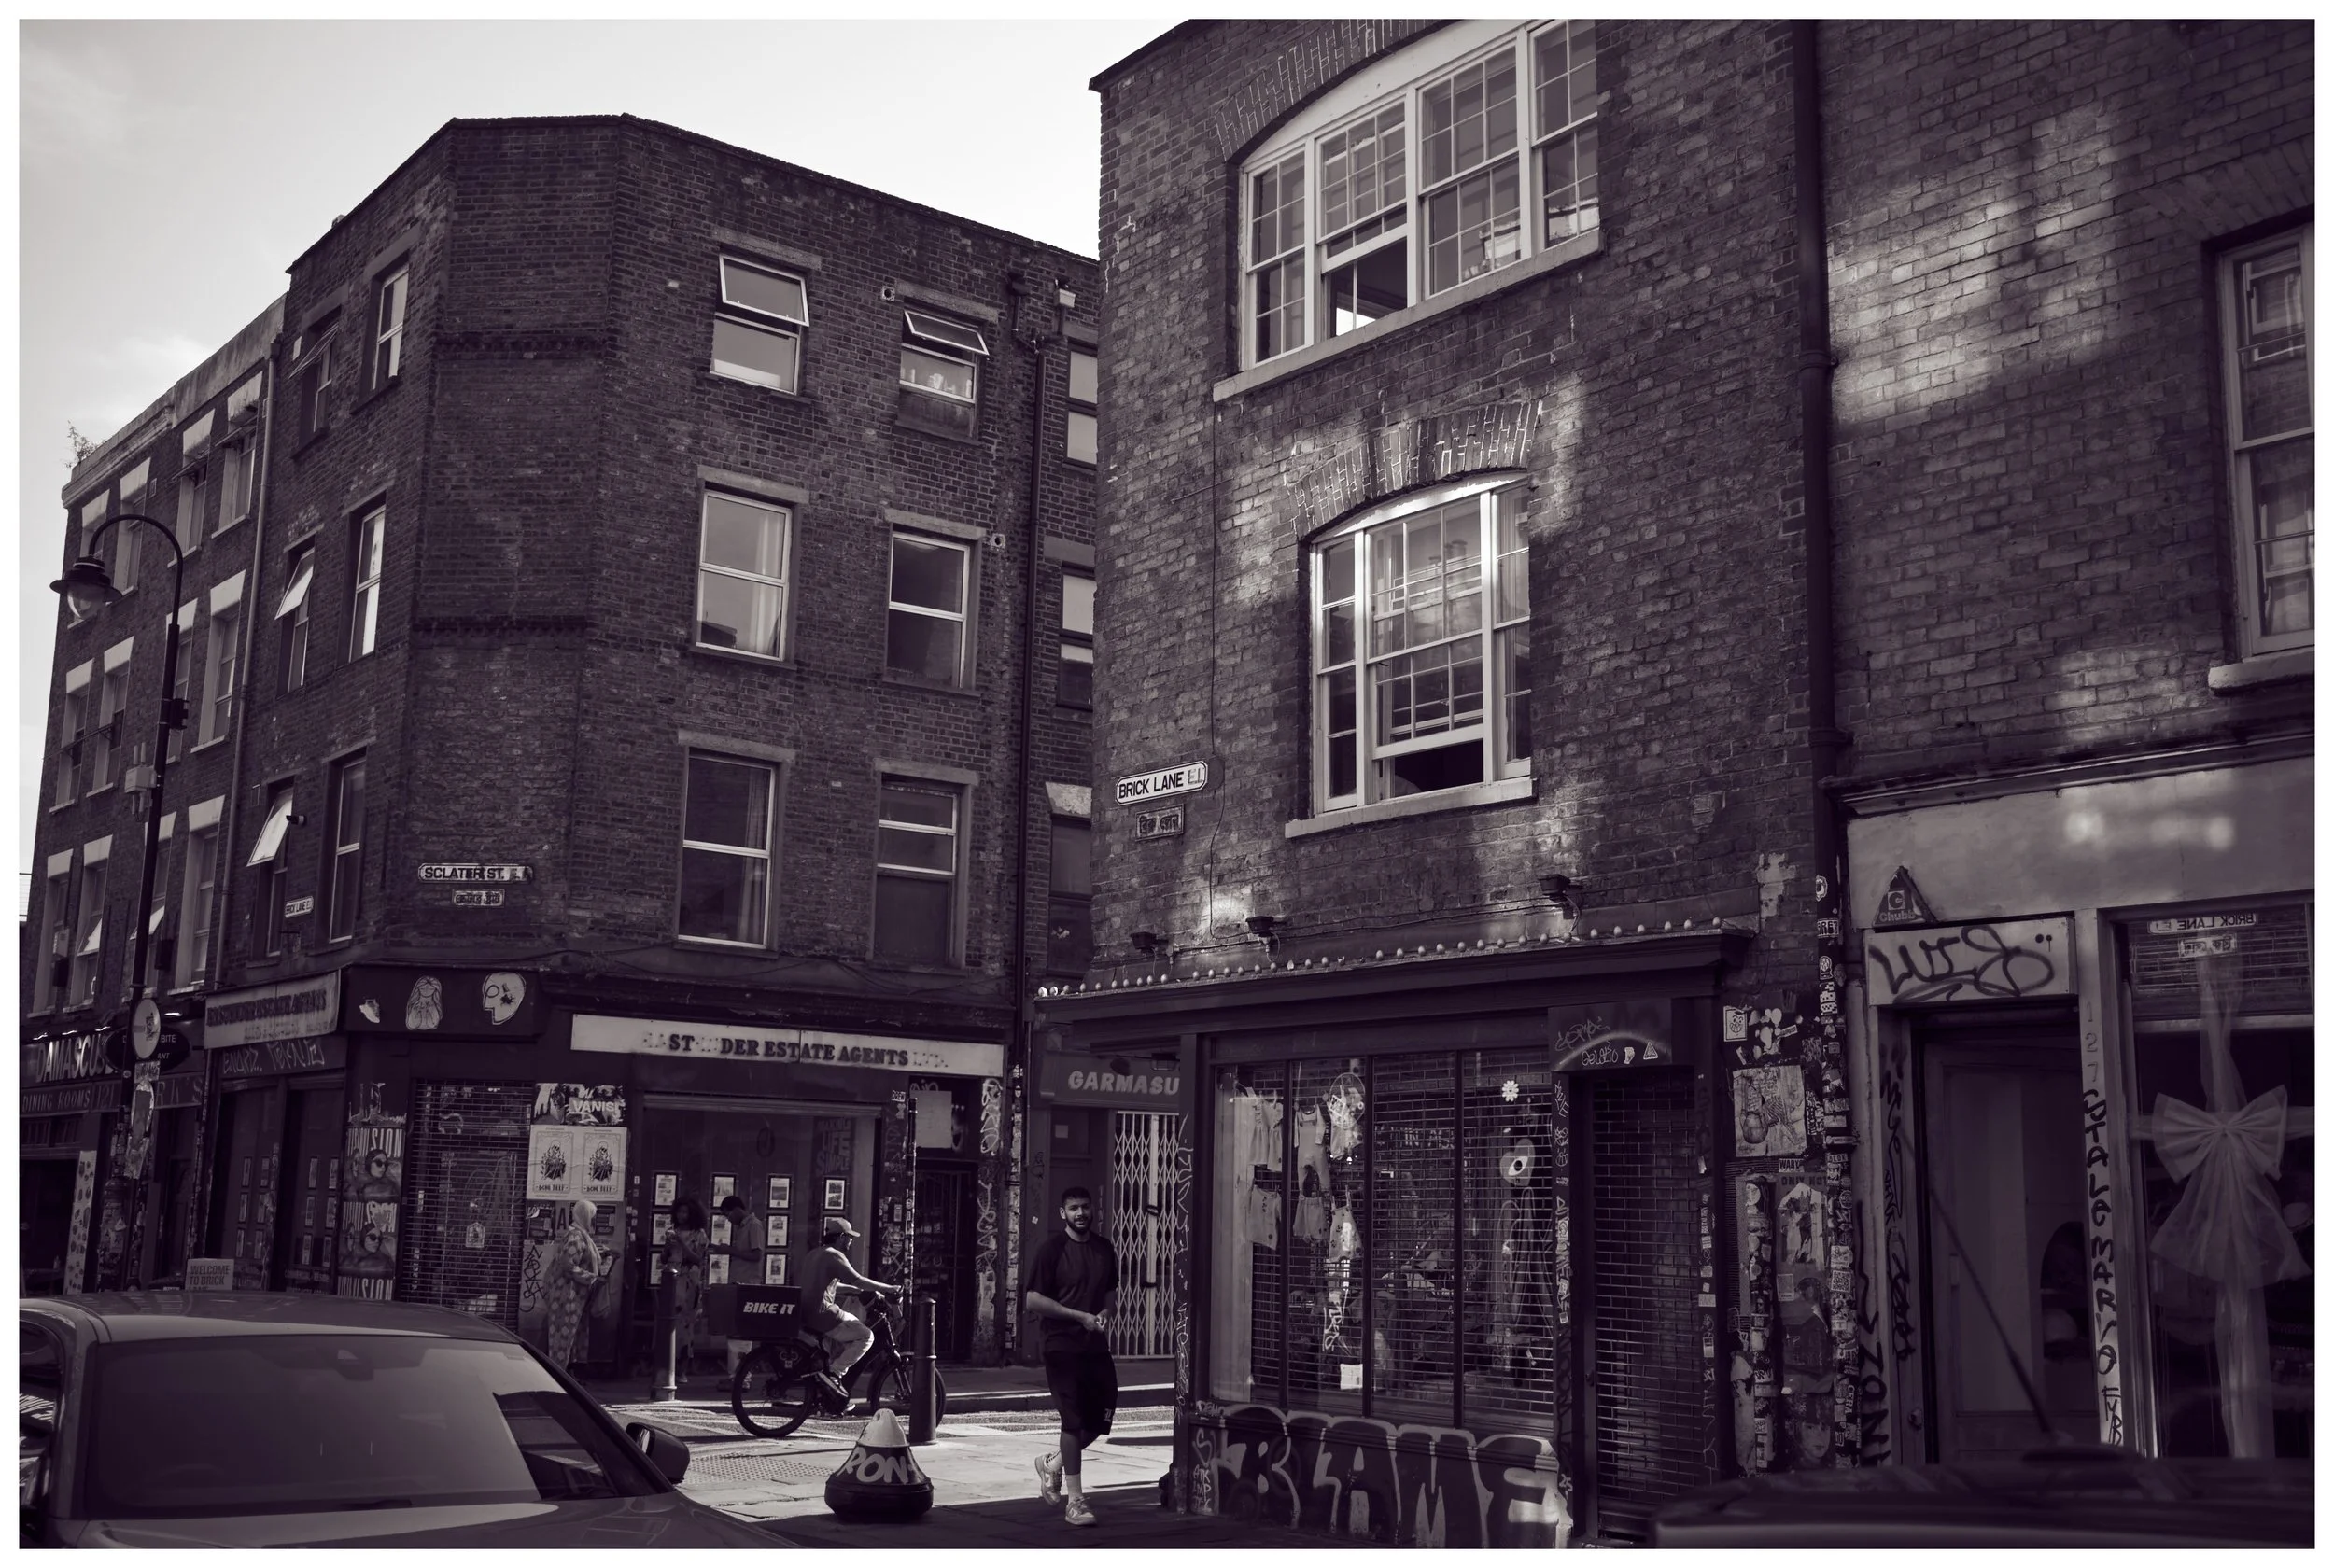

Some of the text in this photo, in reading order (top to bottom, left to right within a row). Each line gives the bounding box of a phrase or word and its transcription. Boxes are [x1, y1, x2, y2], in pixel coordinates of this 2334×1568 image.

[1118, 778, 1150, 799] BRICK
[1154, 771, 1184, 792] LANE
[424, 867, 484, 879] SCLATER
[486, 867, 505, 879] ST.
[160, 1034, 176, 1043] BITE
[764, 1041, 835, 1061] ESTATE
[839, 1046, 909, 1067] AGENTS
[21, 1092, 53, 1113] DINING
[57, 1088, 91, 1110] ROOMS
[822, 1130, 852, 1156] LIFE
[815, 1151, 851, 1175] SIMPLE
[190, 1265, 230, 1275] WELCOME
[190, 1275, 225, 1285] TO BRICK
[743, 1301, 796, 1315] BIKE IT
